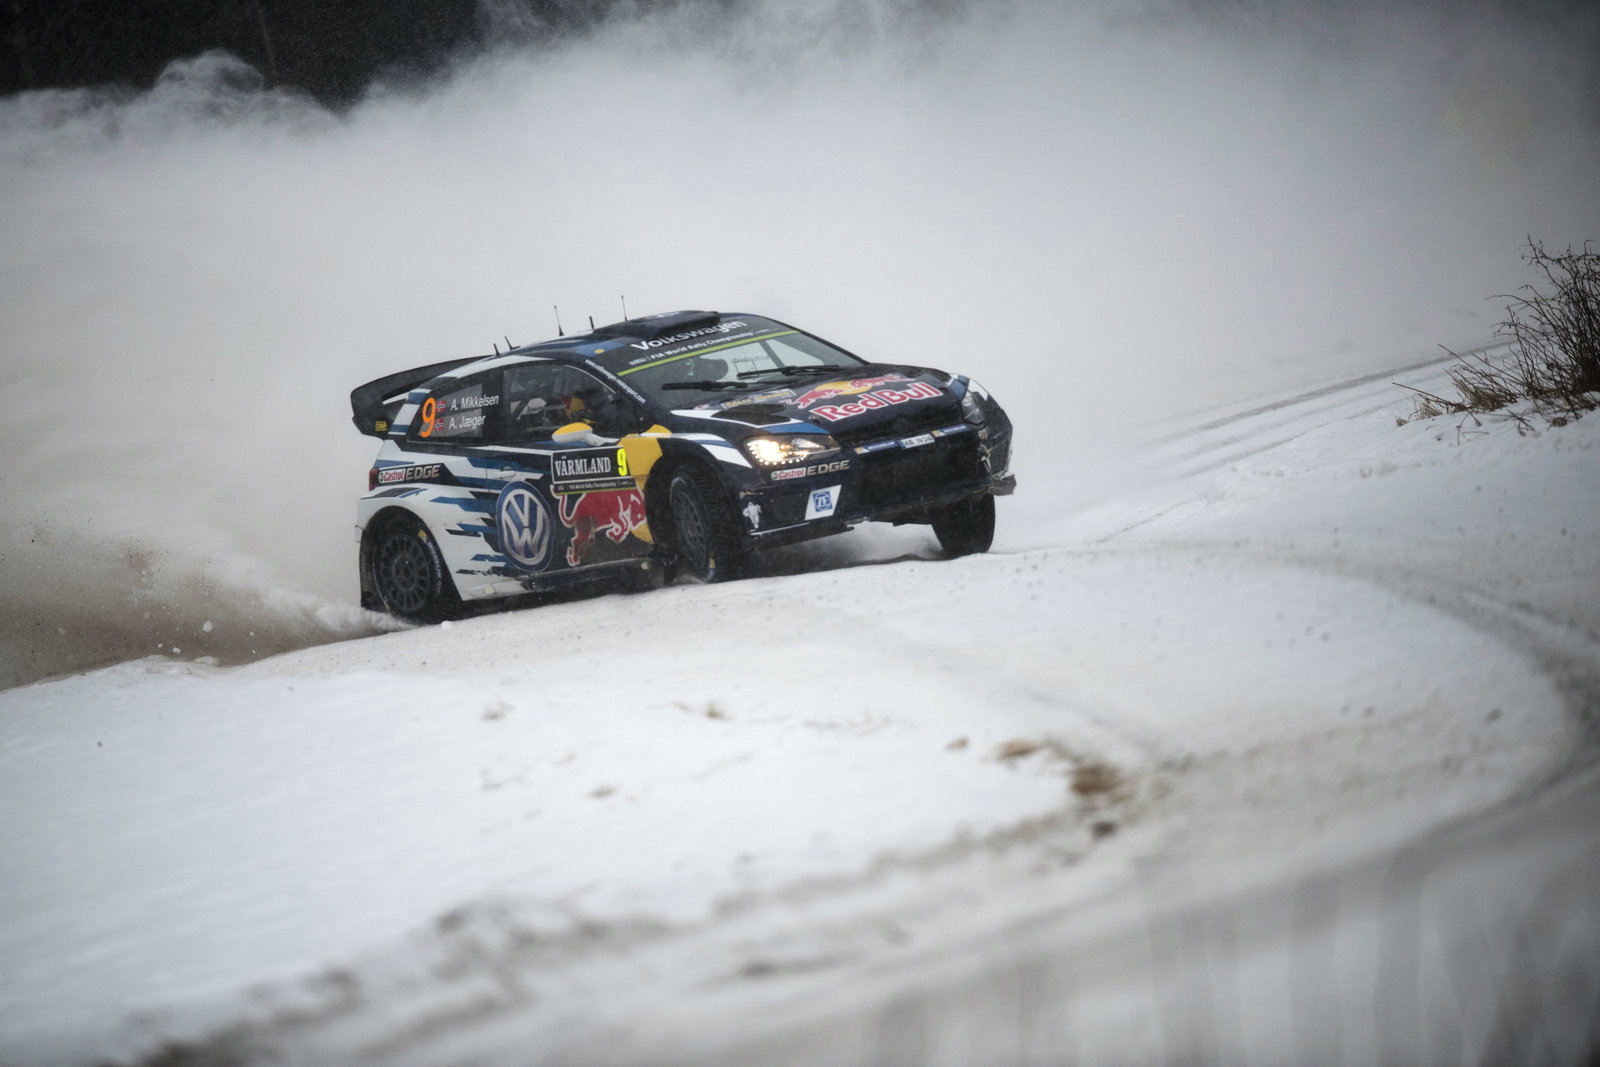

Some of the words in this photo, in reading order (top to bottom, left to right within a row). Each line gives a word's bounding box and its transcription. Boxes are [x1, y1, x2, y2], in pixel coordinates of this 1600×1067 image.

[630, 320, 748, 350] Volkswagen
[664, 345, 688, 356] World
[687, 341, 708, 350] Rally
[450, 398, 459, 411] A.
[460, 395, 499, 410] Mikkelsen
[421, 397, 436, 437] 9
[448, 417, 458, 430] A.
[554, 455, 612, 477] VÄRMLAND
[617, 448, 628, 476] 9
[778, 468, 805, 480] Castrol
[806, 459, 850, 476] EDGE
[383, 470, 405, 482] Castrol
[405, 464, 442, 481] EDGE
